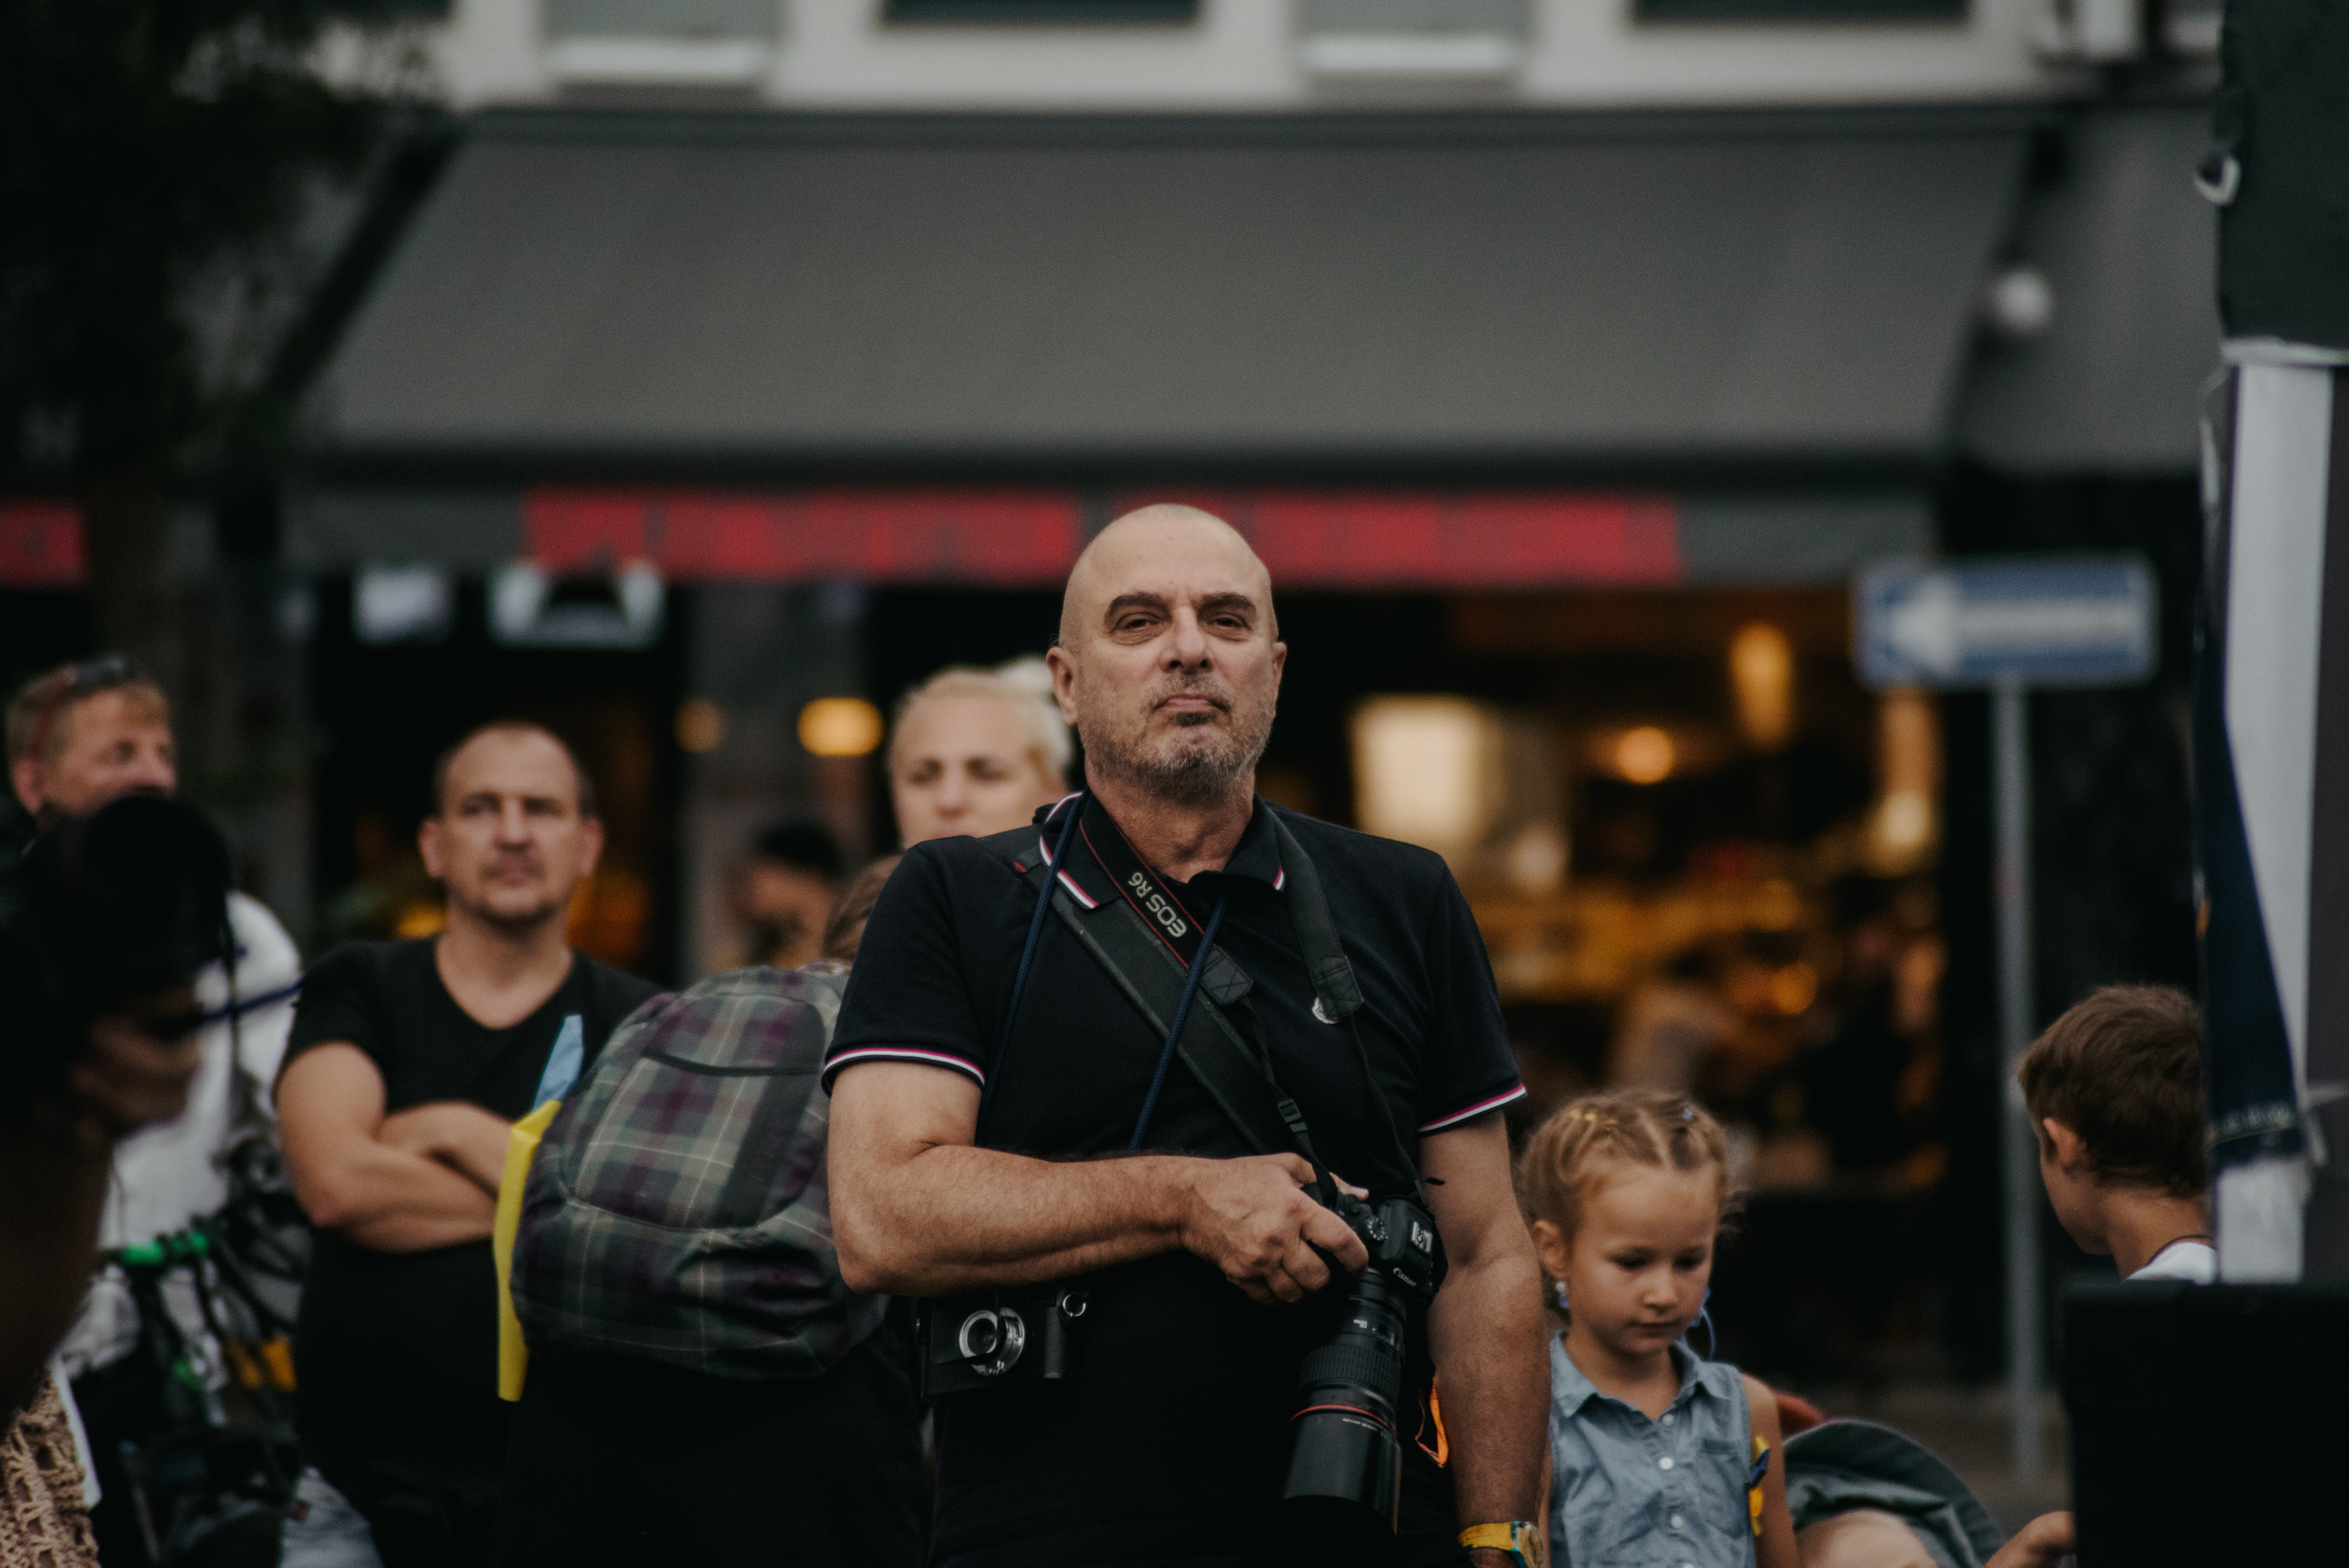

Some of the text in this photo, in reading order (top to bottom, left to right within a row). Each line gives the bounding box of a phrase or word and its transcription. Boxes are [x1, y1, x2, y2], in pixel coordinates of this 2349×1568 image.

[1128, 872, 1186, 938] EOS R6
[1392, 1267, 1417, 1286] Canon
